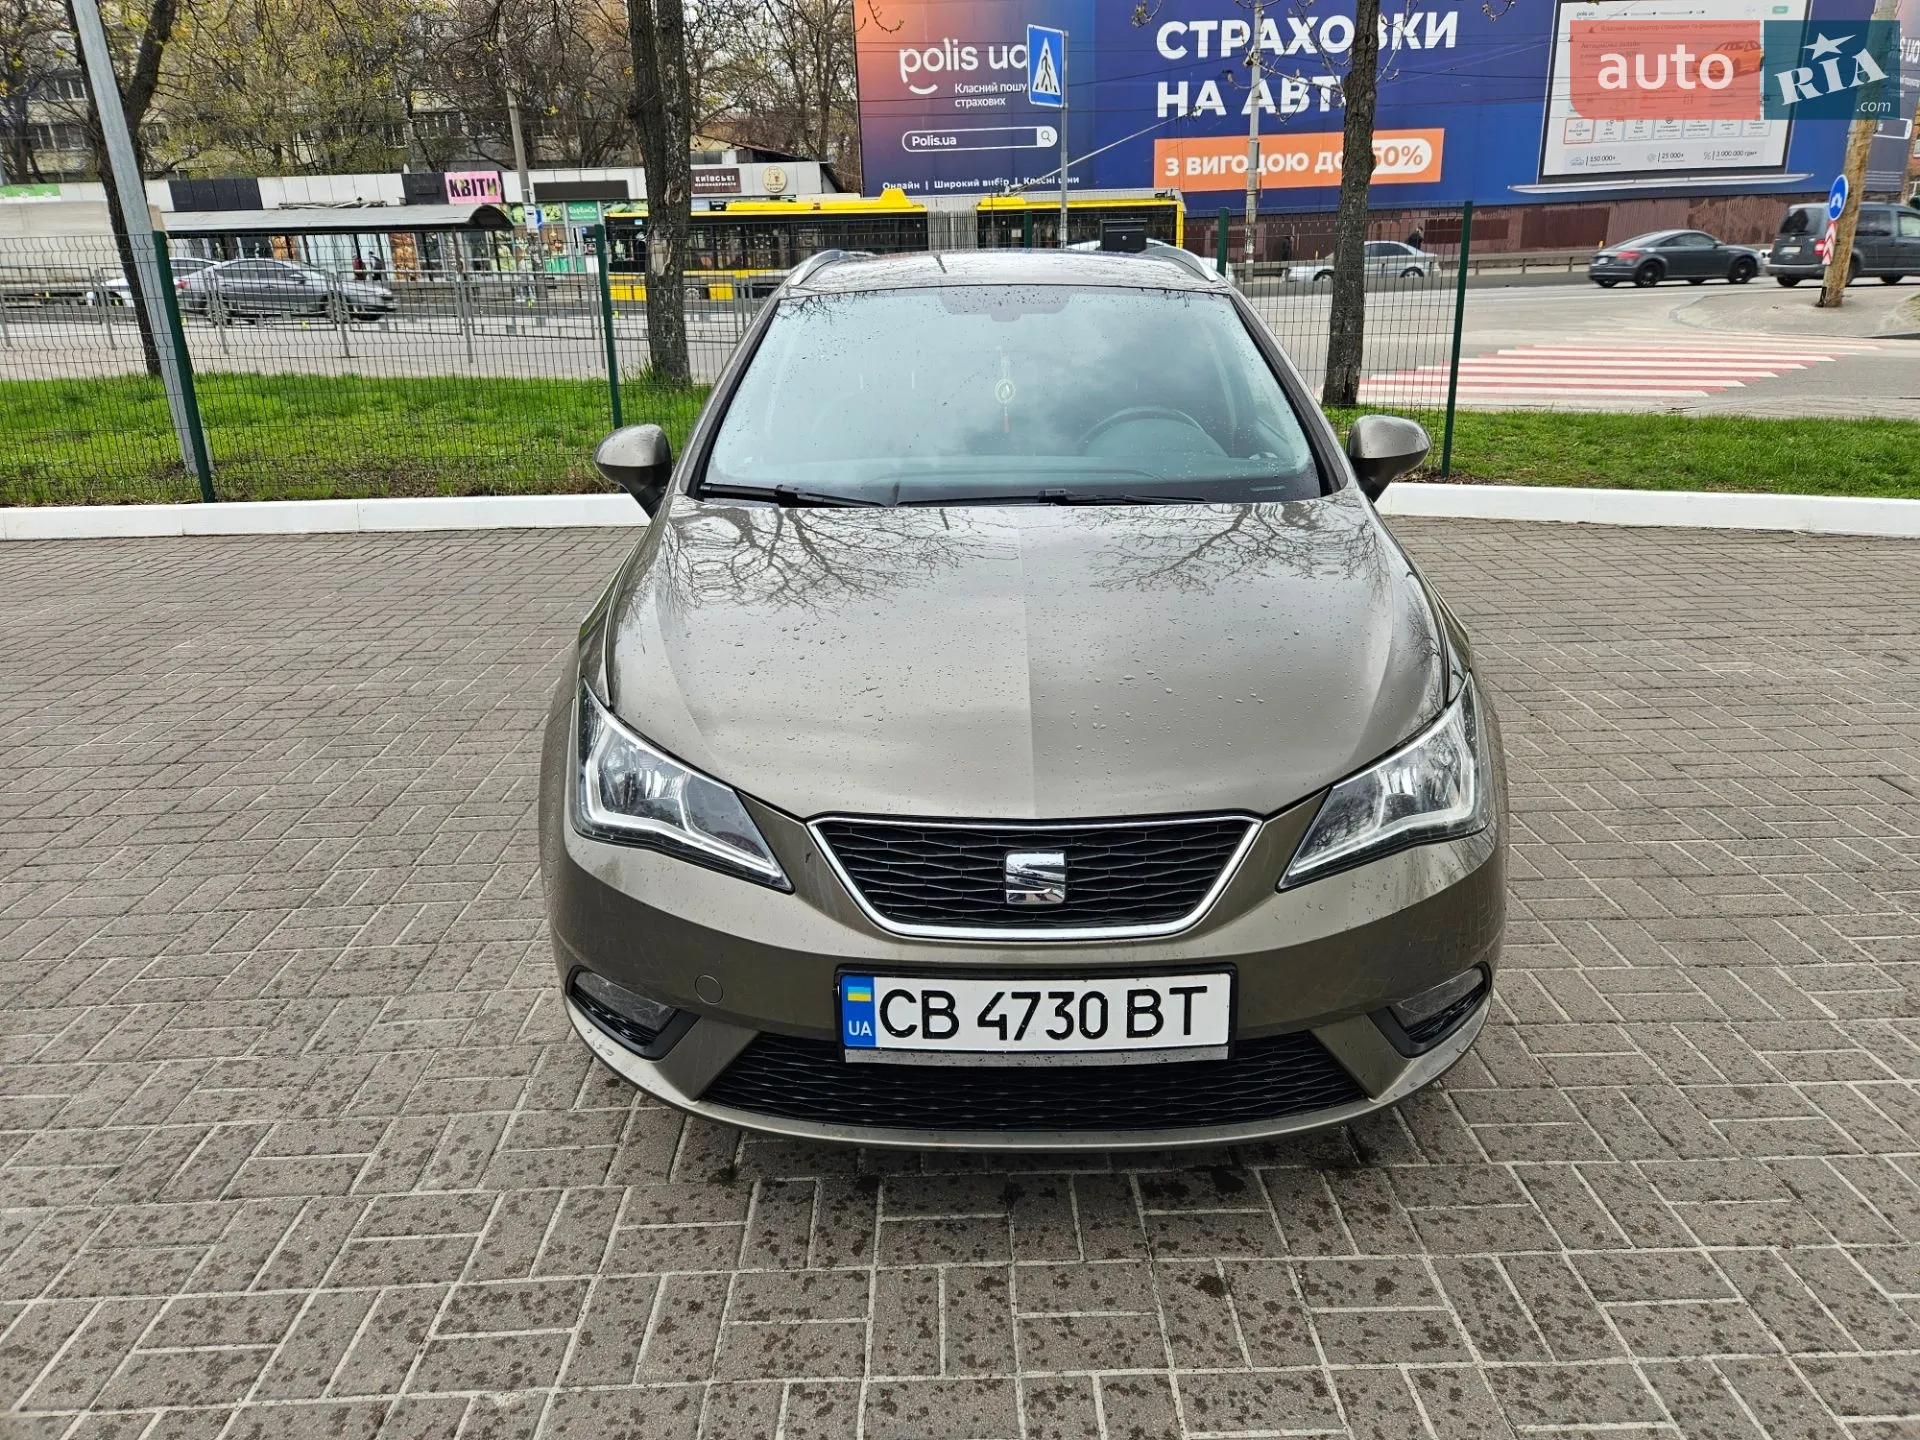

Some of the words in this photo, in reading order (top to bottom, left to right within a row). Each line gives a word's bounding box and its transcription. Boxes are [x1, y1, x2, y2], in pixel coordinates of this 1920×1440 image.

[900, 38, 978, 83] polis
[988, 44, 1028, 70] ua
[955, 82, 998, 95] Класний
[1000, 82, 1028, 95] пошу
[1157, 80, 1227, 118] НА
[1241, 75, 1346, 116] АВТ
[955, 97, 1006, 108] страхових
[912, 135, 957, 147] Polis.ua
[449, 178, 498, 197] КВІТИ
[882, 181, 920, 190] Онлайн
[934, 179, 980, 189] Широкий
[879, 988, 960, 1040] CB
[977, 991, 1108, 1041] 4730
[1126, 985, 1208, 1038] BT
[848, 1020, 873, 1037] UA
